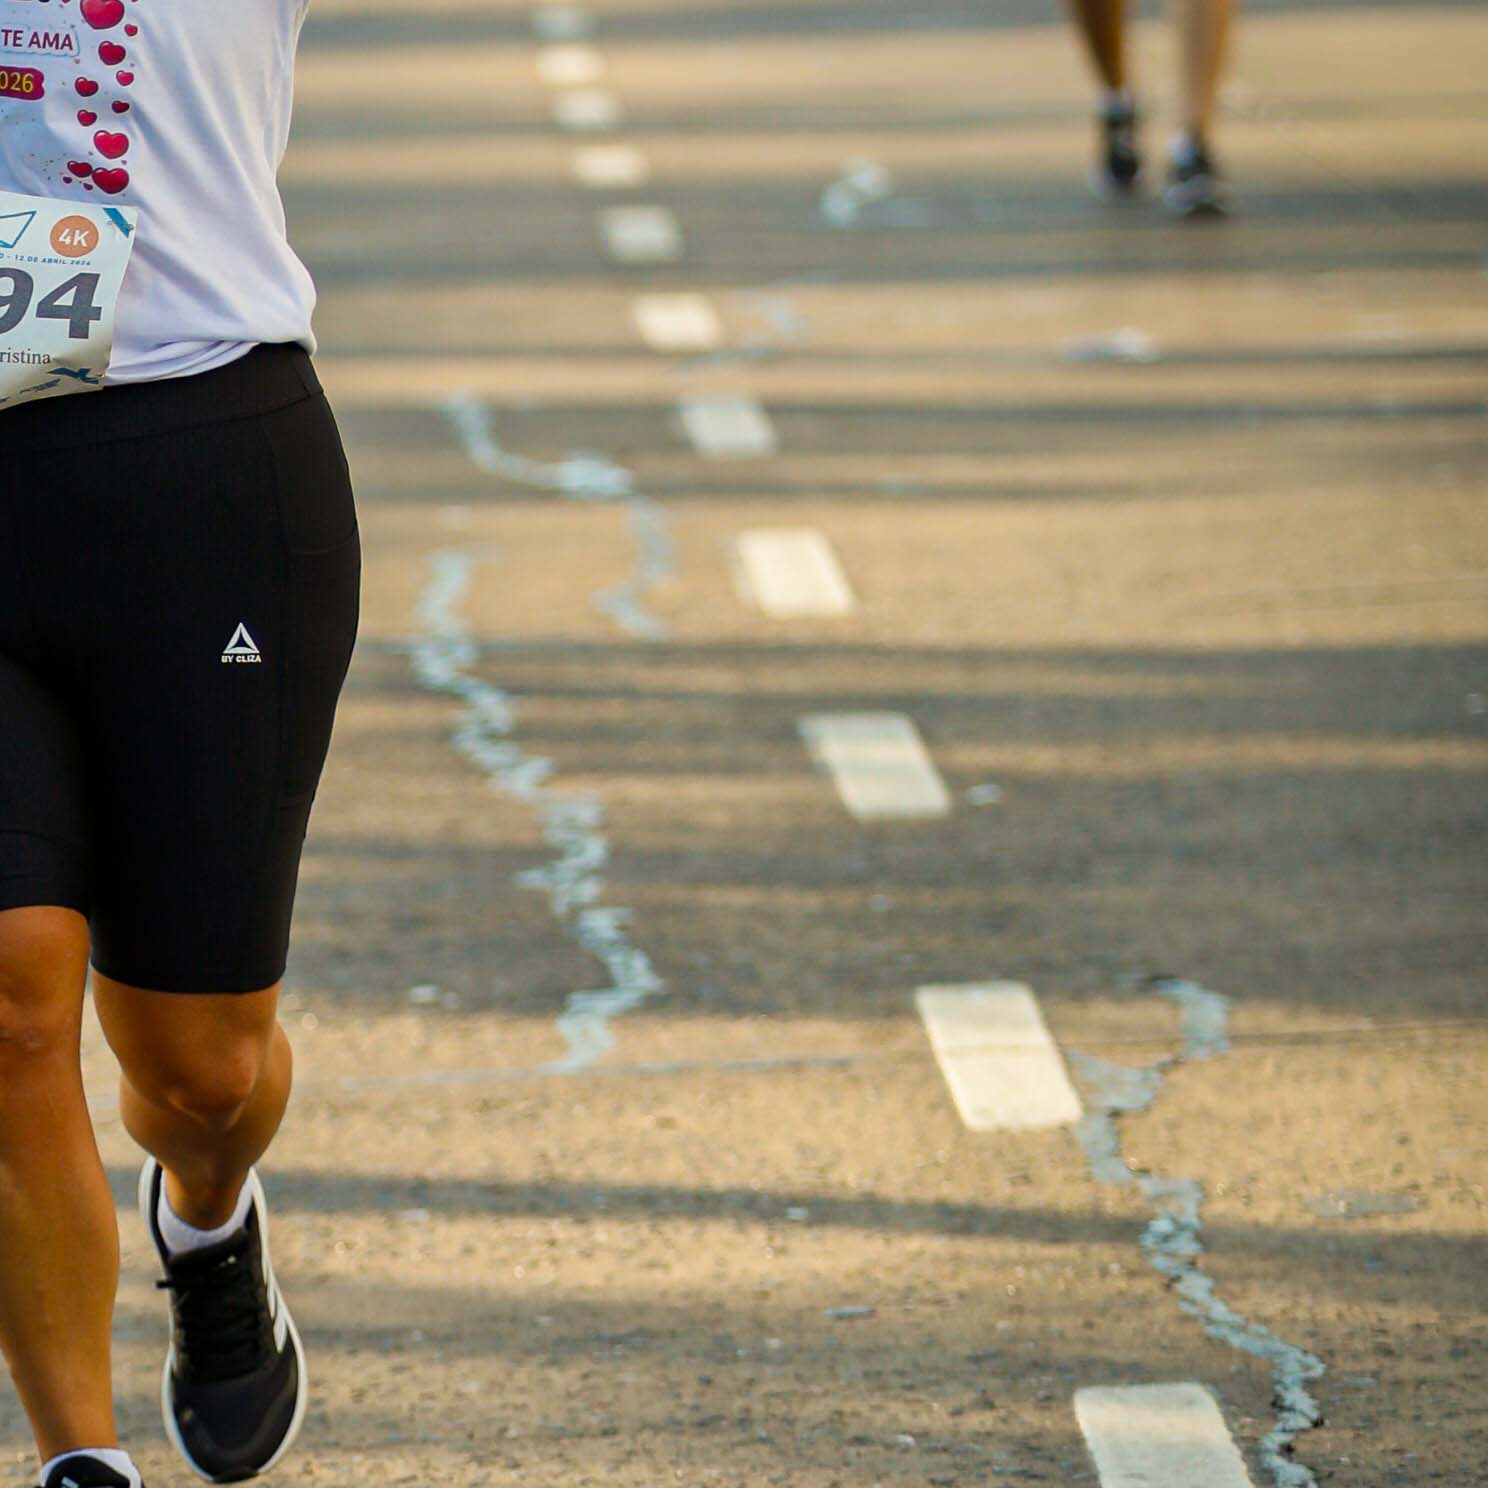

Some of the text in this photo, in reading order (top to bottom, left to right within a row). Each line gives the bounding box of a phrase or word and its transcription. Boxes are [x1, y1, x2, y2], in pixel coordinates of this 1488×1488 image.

[1, 29, 24, 47] TE
[28, 31, 73, 51] AMA
[58, 228, 89, 247] 4K
[27, 255, 38, 263] DE
